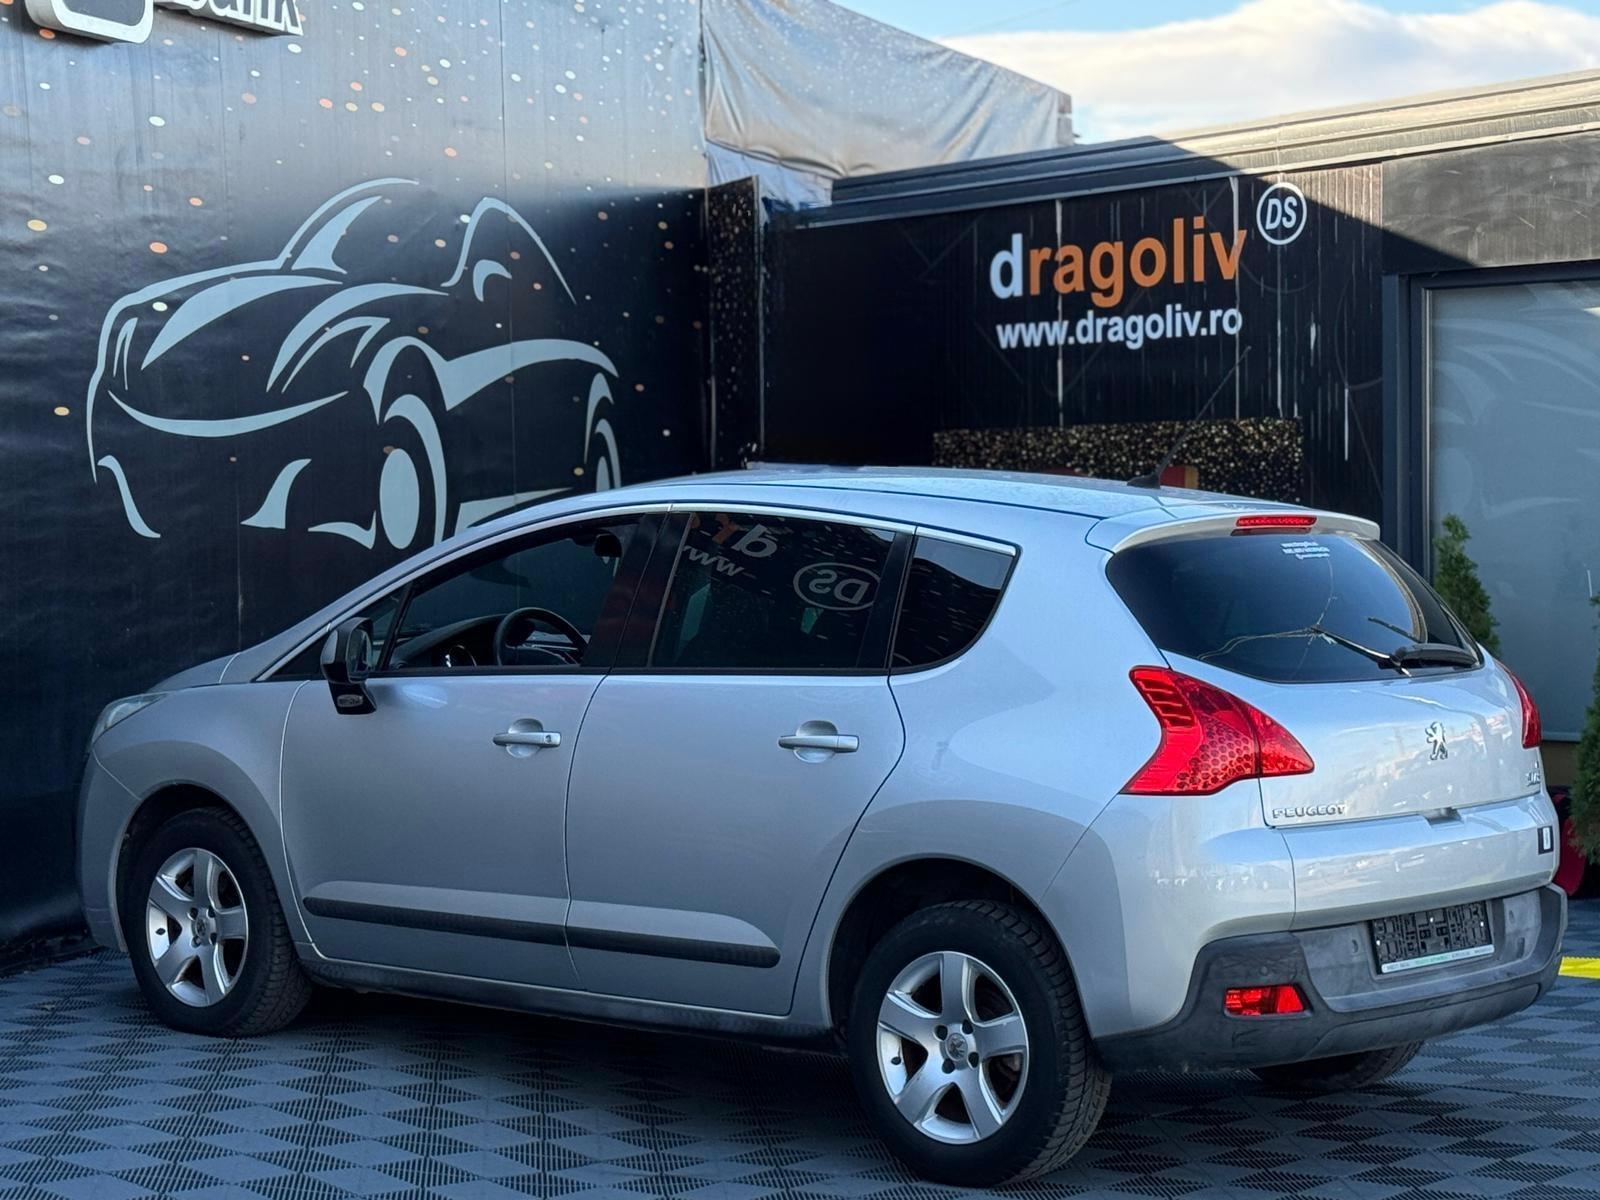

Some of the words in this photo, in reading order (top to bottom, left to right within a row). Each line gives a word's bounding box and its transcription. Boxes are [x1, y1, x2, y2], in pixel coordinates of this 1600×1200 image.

[1265, 196, 1298, 230] DS
[989, 215, 1247, 308] dragoliv
[996, 303, 1243, 350] www.dragoliv.ro
[1272, 799, 1346, 819] PEUGEOT
